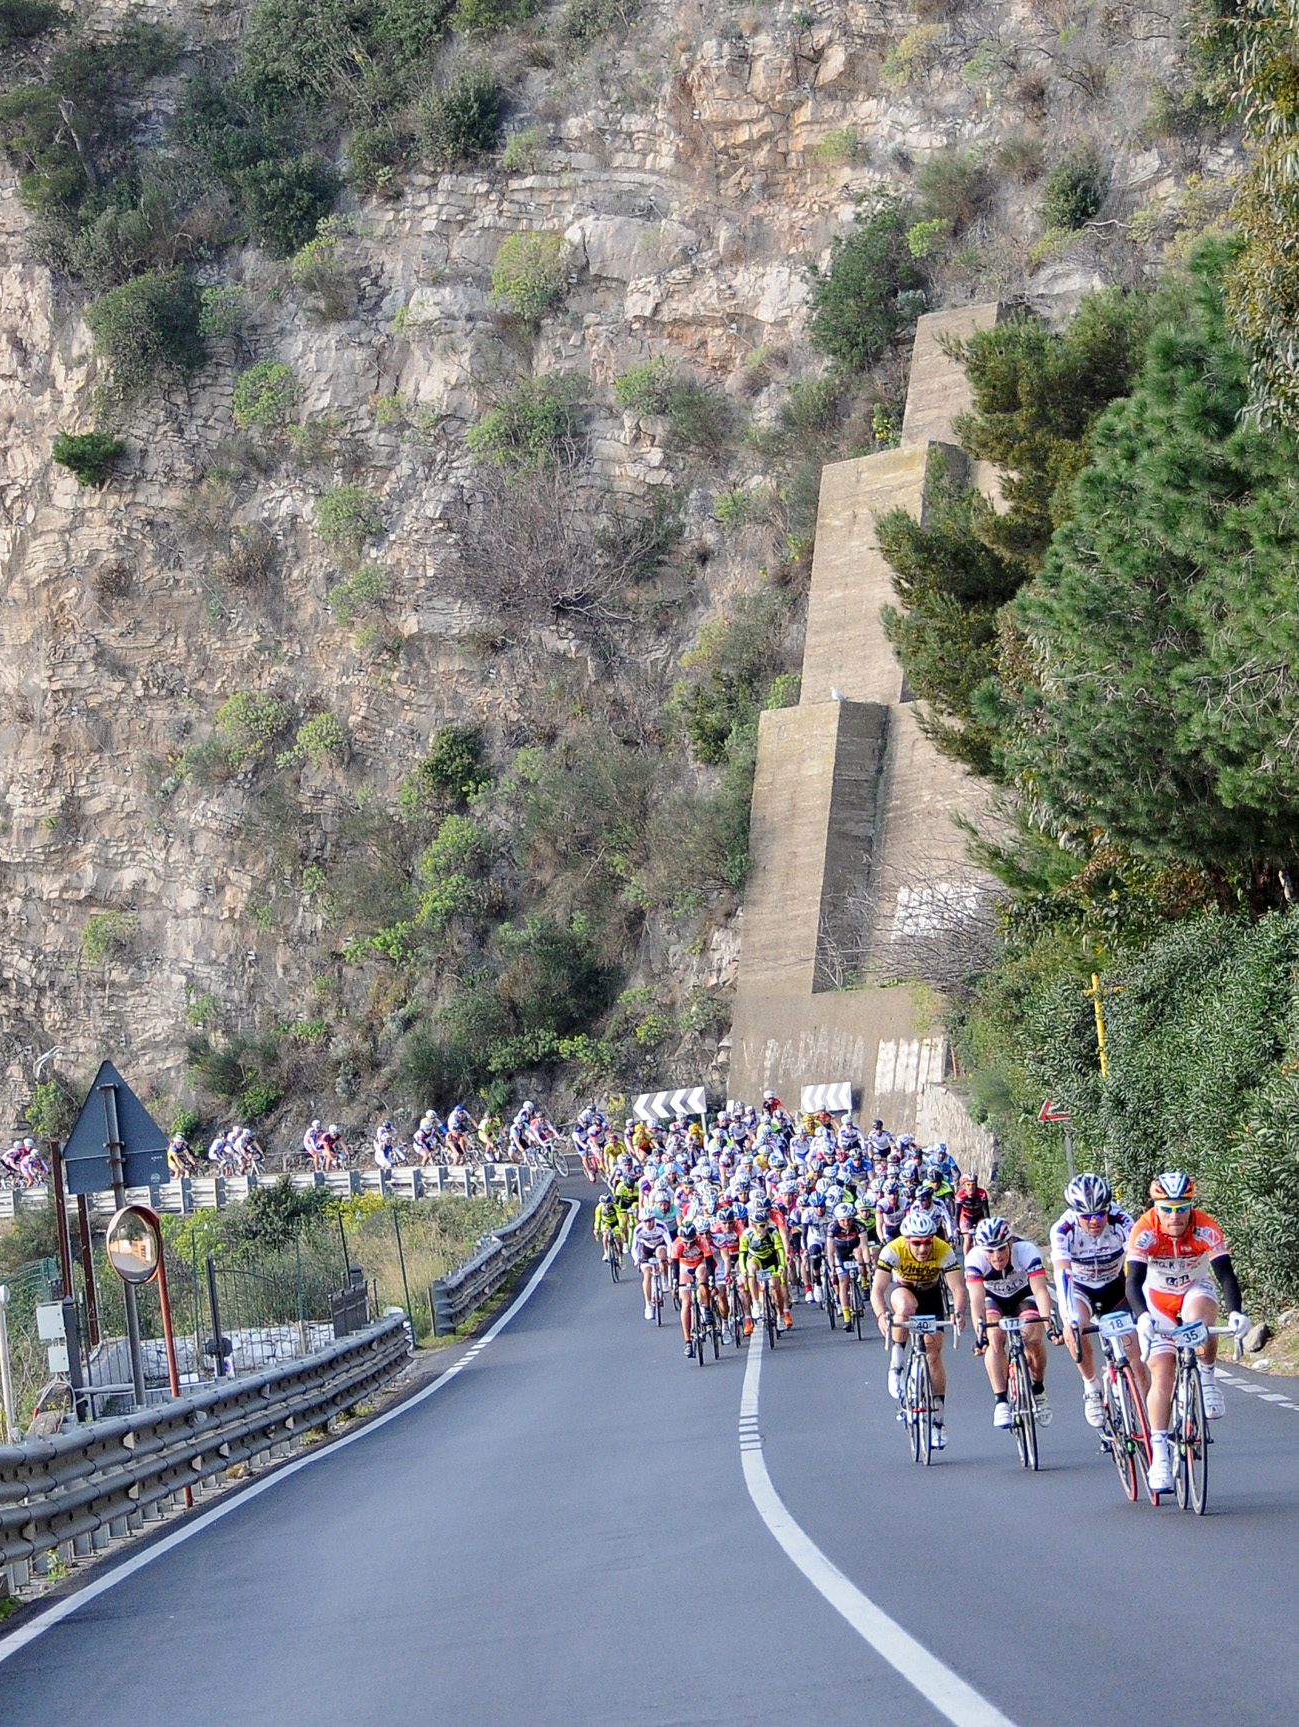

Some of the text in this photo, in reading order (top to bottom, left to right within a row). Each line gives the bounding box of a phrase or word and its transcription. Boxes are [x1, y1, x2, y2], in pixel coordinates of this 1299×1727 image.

[916, 1321, 929, 1330] 40
[1004, 1319, 1020, 1329] 177
[1109, 1318, 1124, 1330] 18
[1183, 1330, 1199, 1343] 35
